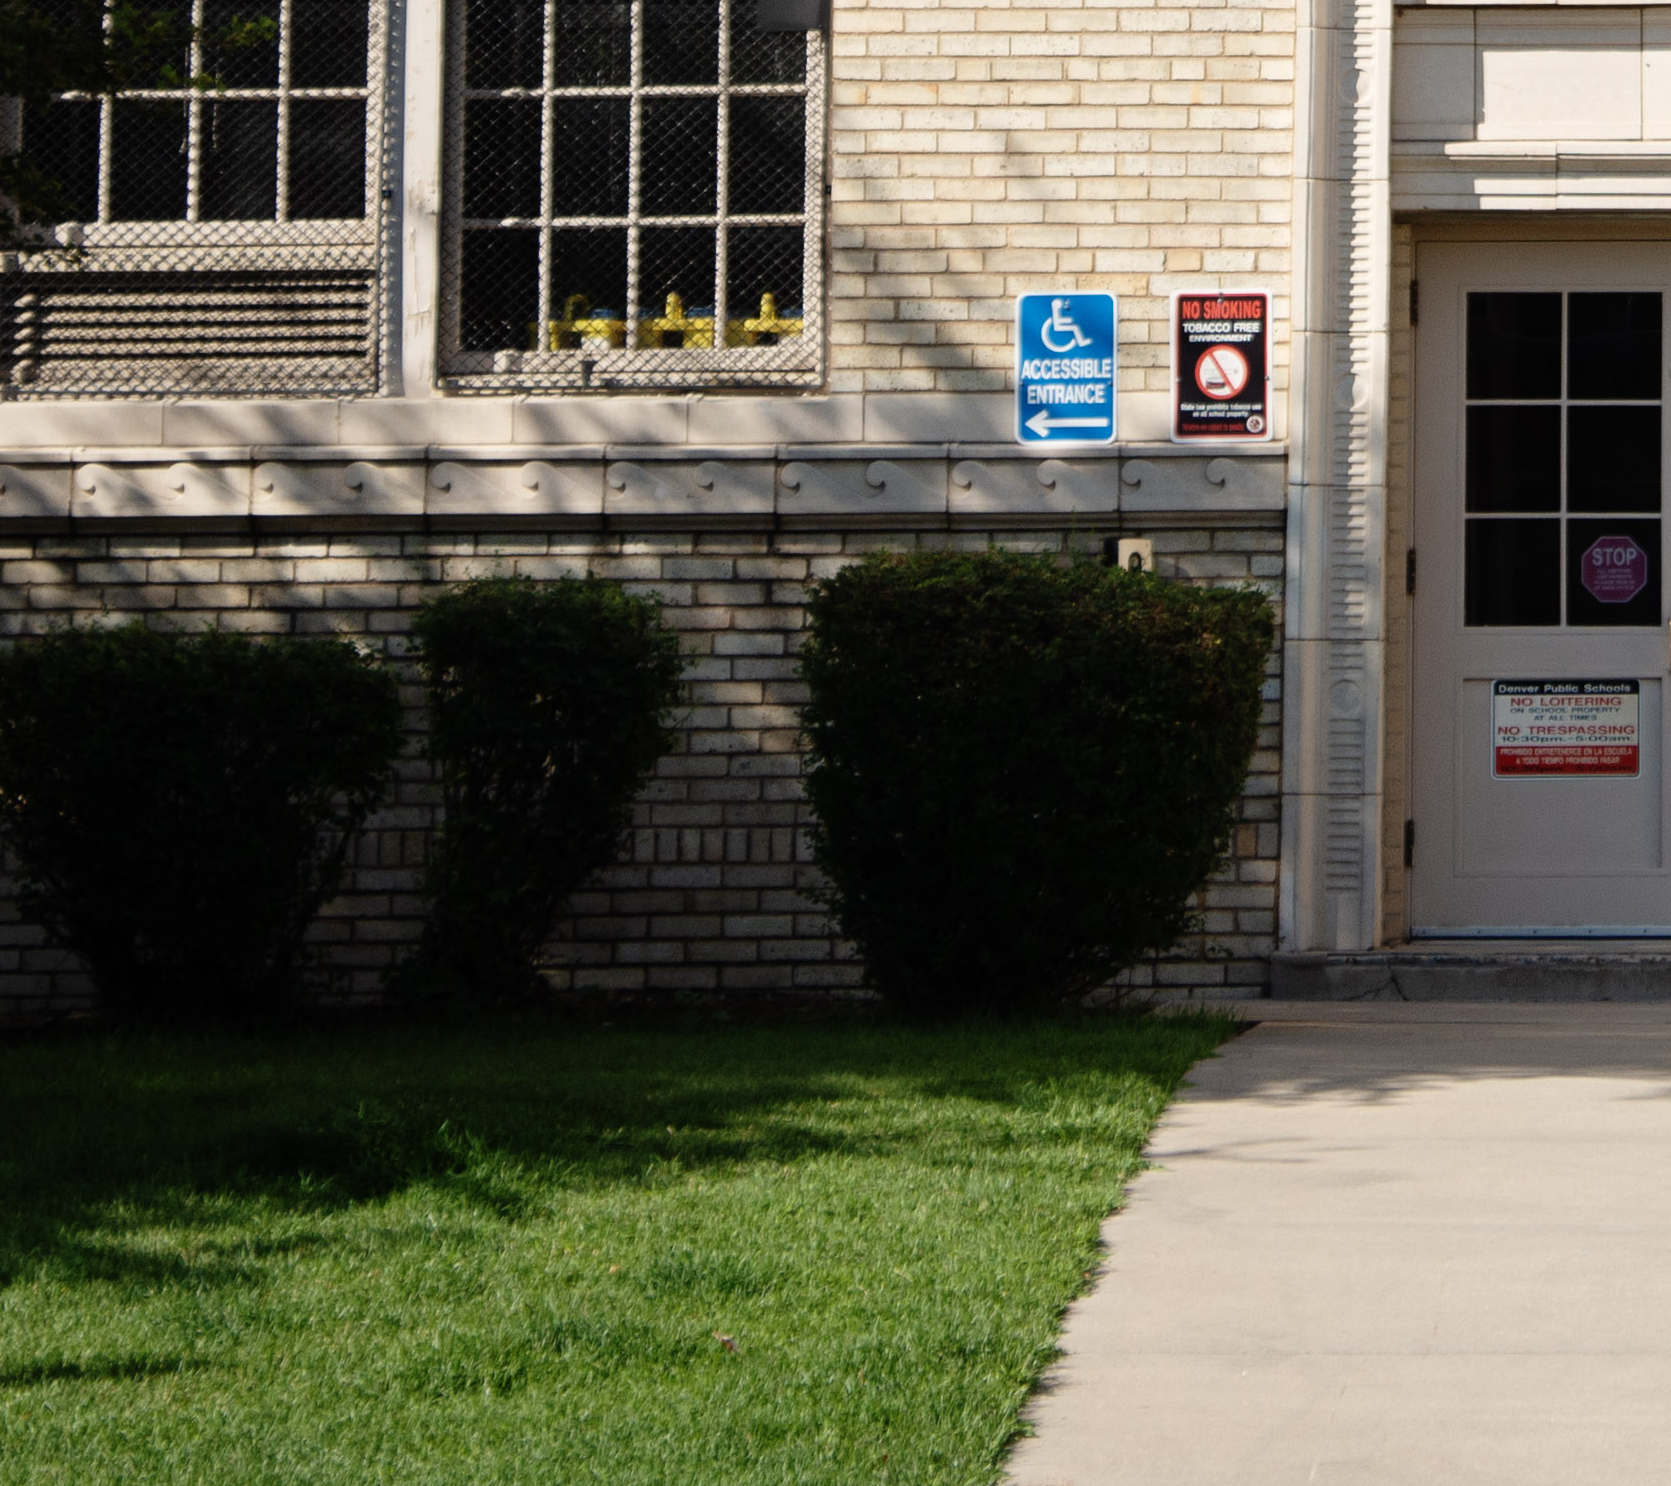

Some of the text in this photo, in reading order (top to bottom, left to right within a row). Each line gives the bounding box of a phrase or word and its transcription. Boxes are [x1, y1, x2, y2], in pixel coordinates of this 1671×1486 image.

[1182, 300, 1261, 319] NO SMOKING
[1182, 322, 1260, 333] TOBACCO FREE
[1189, 334, 1252, 342] ENVIRONMENT
[1021, 358, 1113, 380] ACCESSIBLE
[1027, 384, 1106, 405] ENTRANCE
[1592, 548, 1637, 566] STOP
[1498, 683, 1632, 694] Denver Public Schools
[1510, 697, 1622, 707] NO LOITERING
[1571, 706, 1620, 714] PROPERTY
[1497, 725, 1635, 736] NO TRESPASSING
